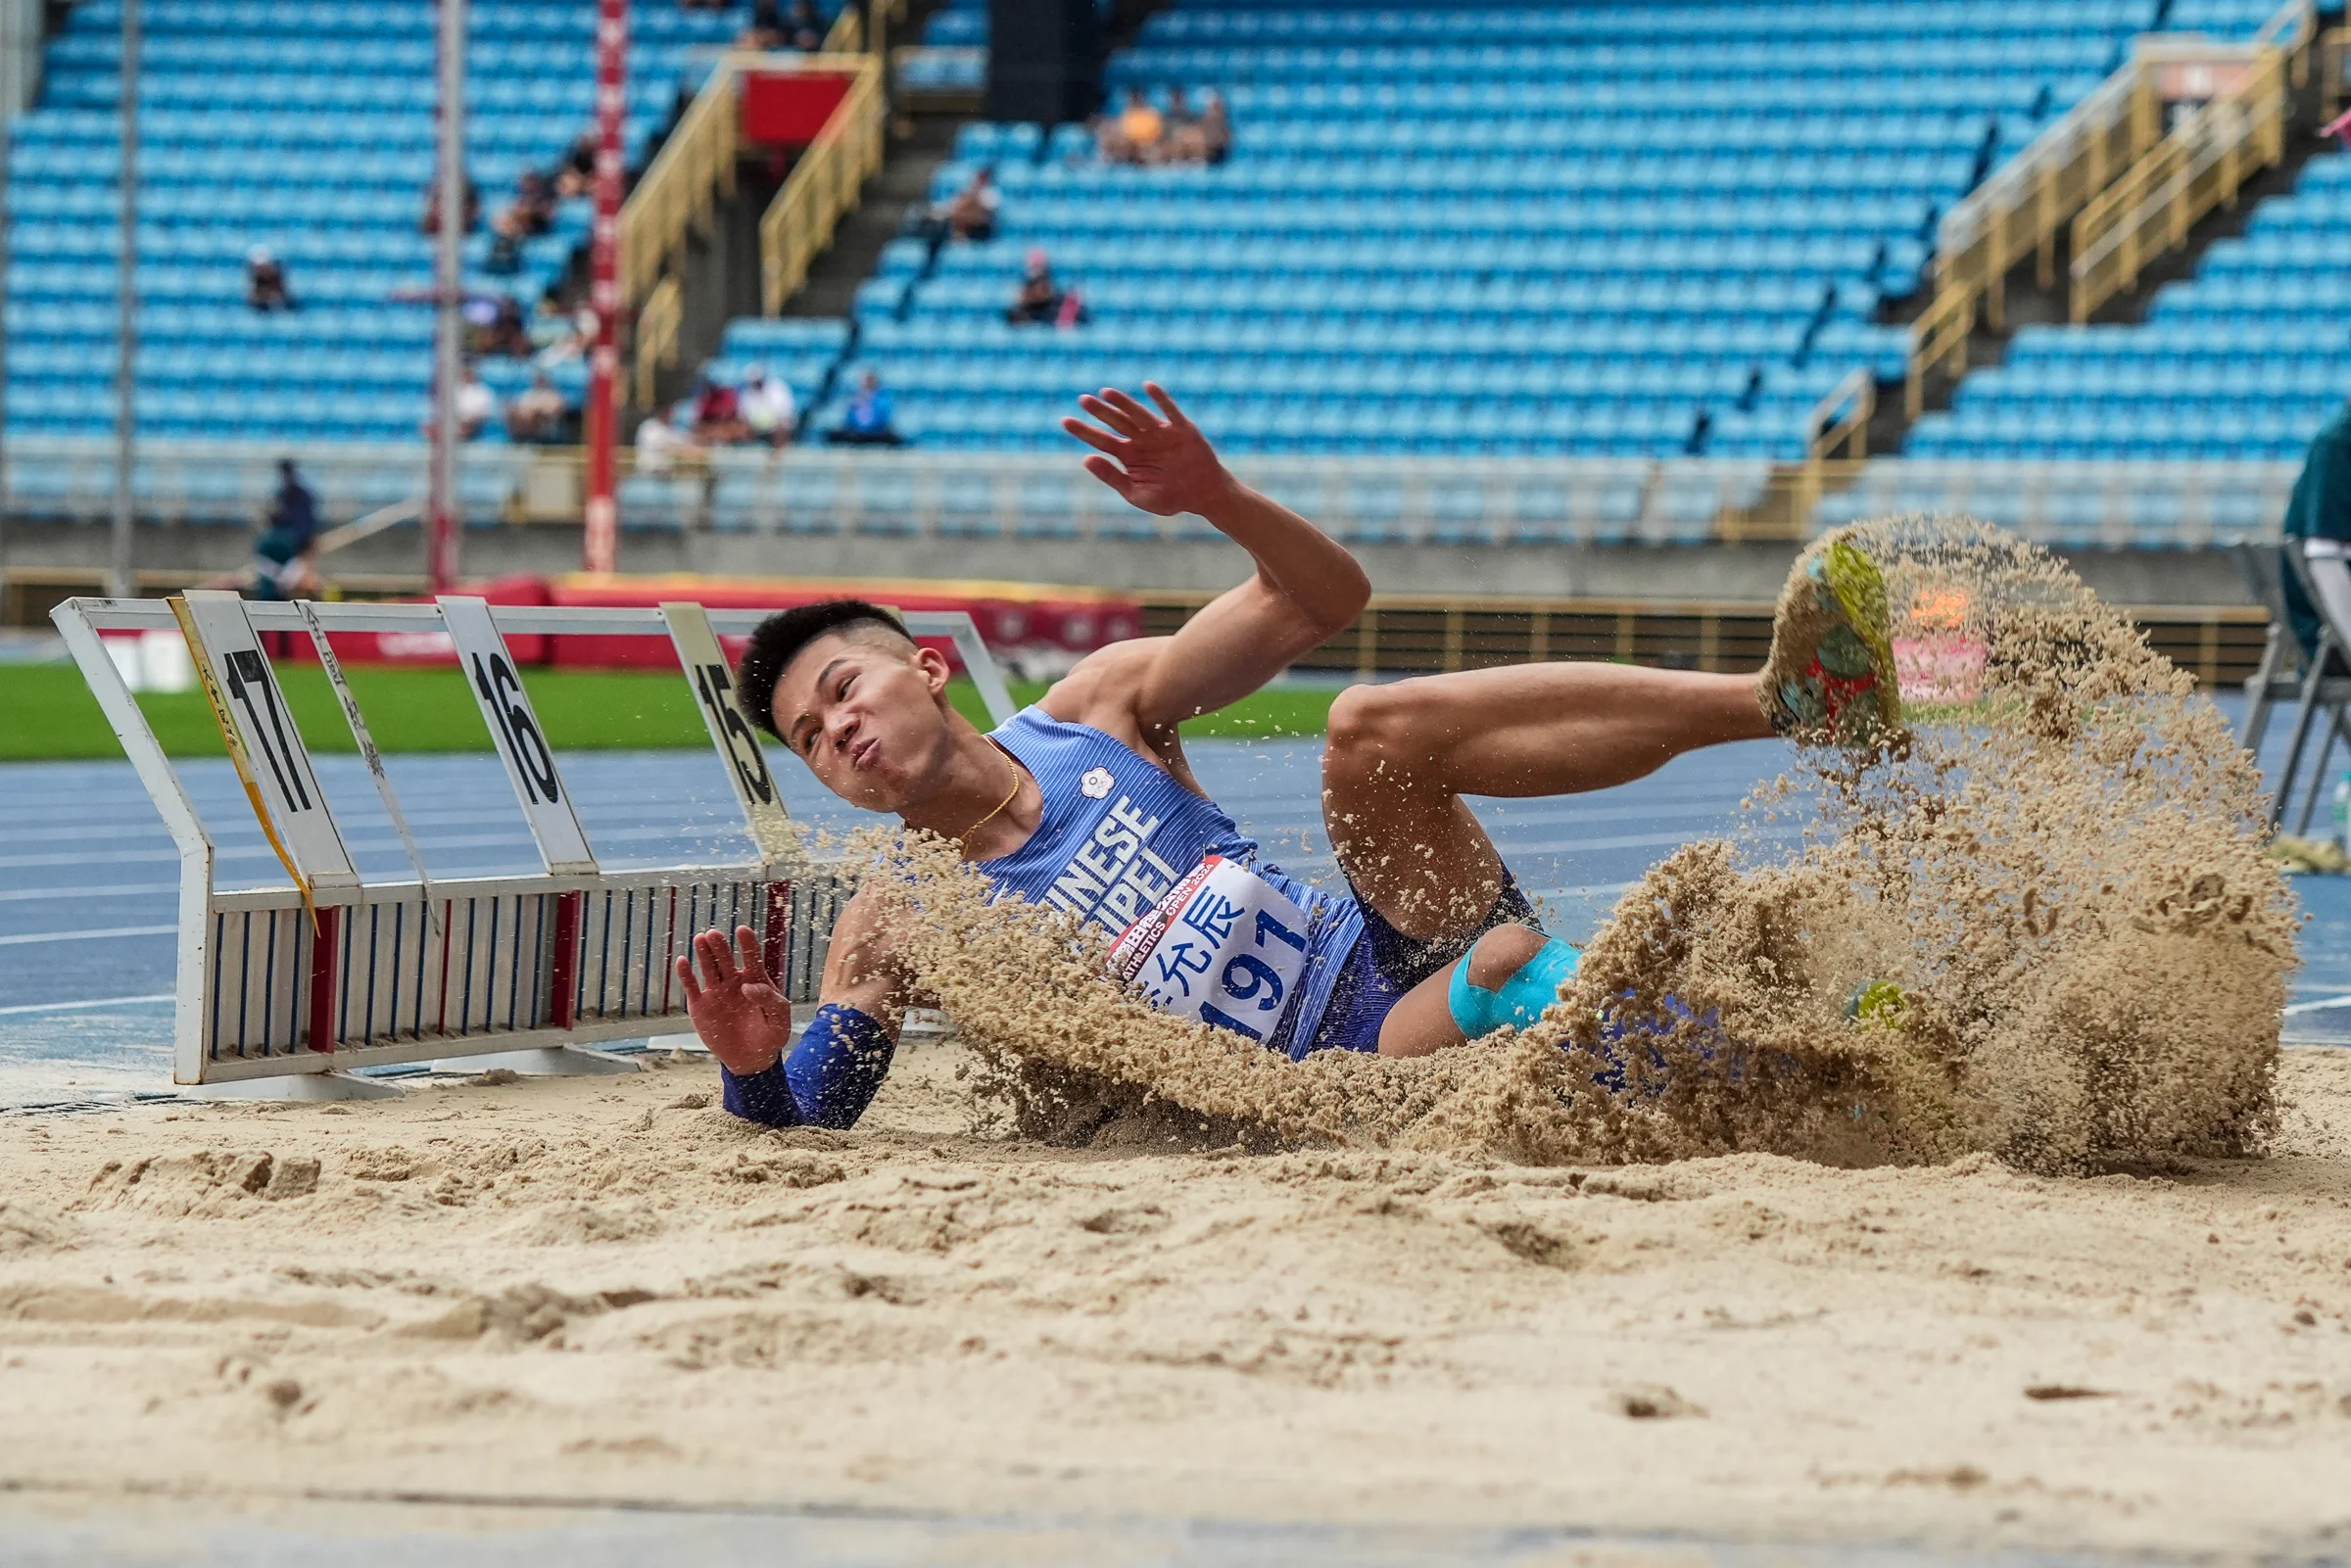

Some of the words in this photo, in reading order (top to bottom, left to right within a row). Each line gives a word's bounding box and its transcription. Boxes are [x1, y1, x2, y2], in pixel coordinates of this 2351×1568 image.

[223, 649, 312, 813] 17
[471, 652, 558, 805] 16
[694, 664, 772, 806] 15
[1036, 794, 1160, 925] INESE
[1122, 921, 1166, 980] ATHLETICS
[1166, 886, 1194, 917] OPEN
[1190, 863, 1215, 887] 2024
[1198, 909, 1308, 1043] 191
